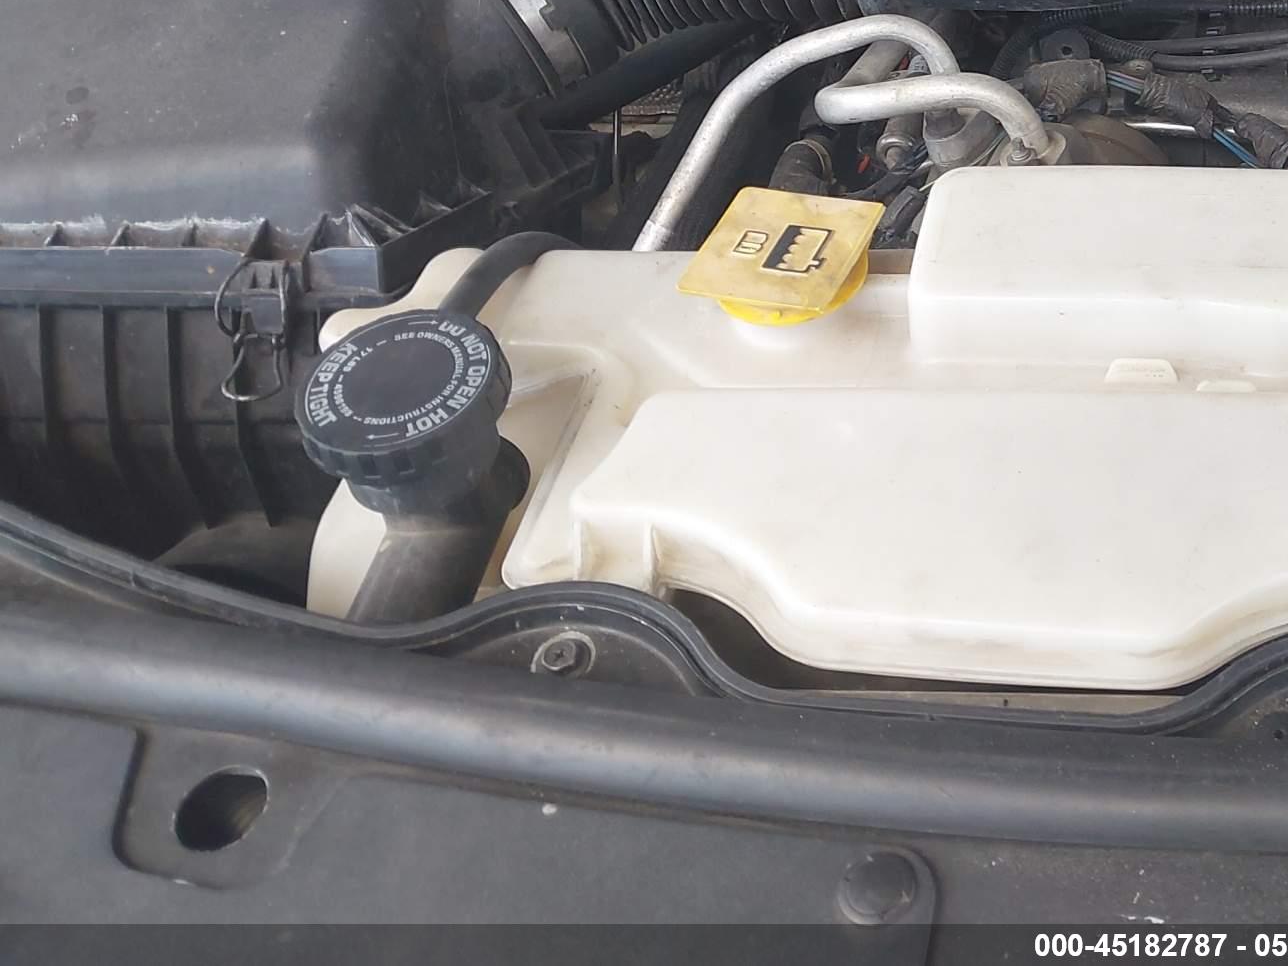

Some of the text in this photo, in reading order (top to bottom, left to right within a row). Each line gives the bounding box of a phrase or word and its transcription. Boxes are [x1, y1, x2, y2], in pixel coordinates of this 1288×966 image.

[394, 331, 416, 341] SEE
[460, 334, 488, 361] NOT
[450, 346, 465, 380] MANUAL
[309, 342, 359, 427] KEEP TIGHT
[440, 379, 459, 397] FOR
[446, 365, 486, 410] OPEN
[362, 394, 445, 425] INSTRUCTIONS
[405, 408, 449, 437] HOT
